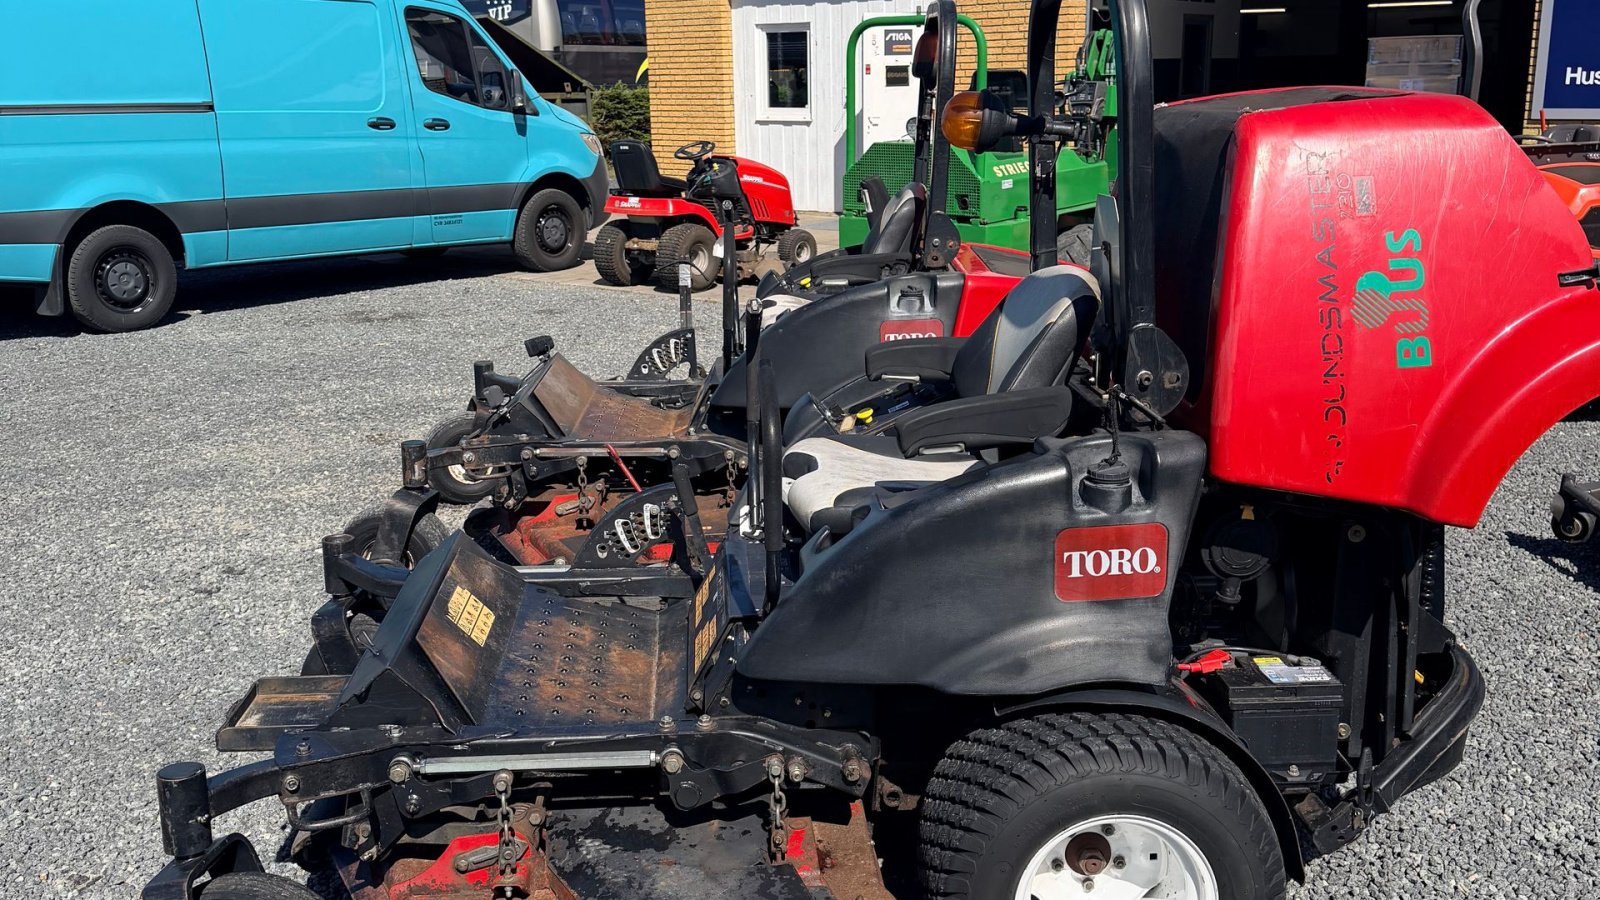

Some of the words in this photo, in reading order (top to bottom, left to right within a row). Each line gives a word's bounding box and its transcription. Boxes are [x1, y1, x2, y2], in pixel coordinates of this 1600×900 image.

[488, 4, 512, 20] VIP
[885, 32, 912, 41] STIGA
[1305, 151, 1348, 484] OUNDSMASTER
